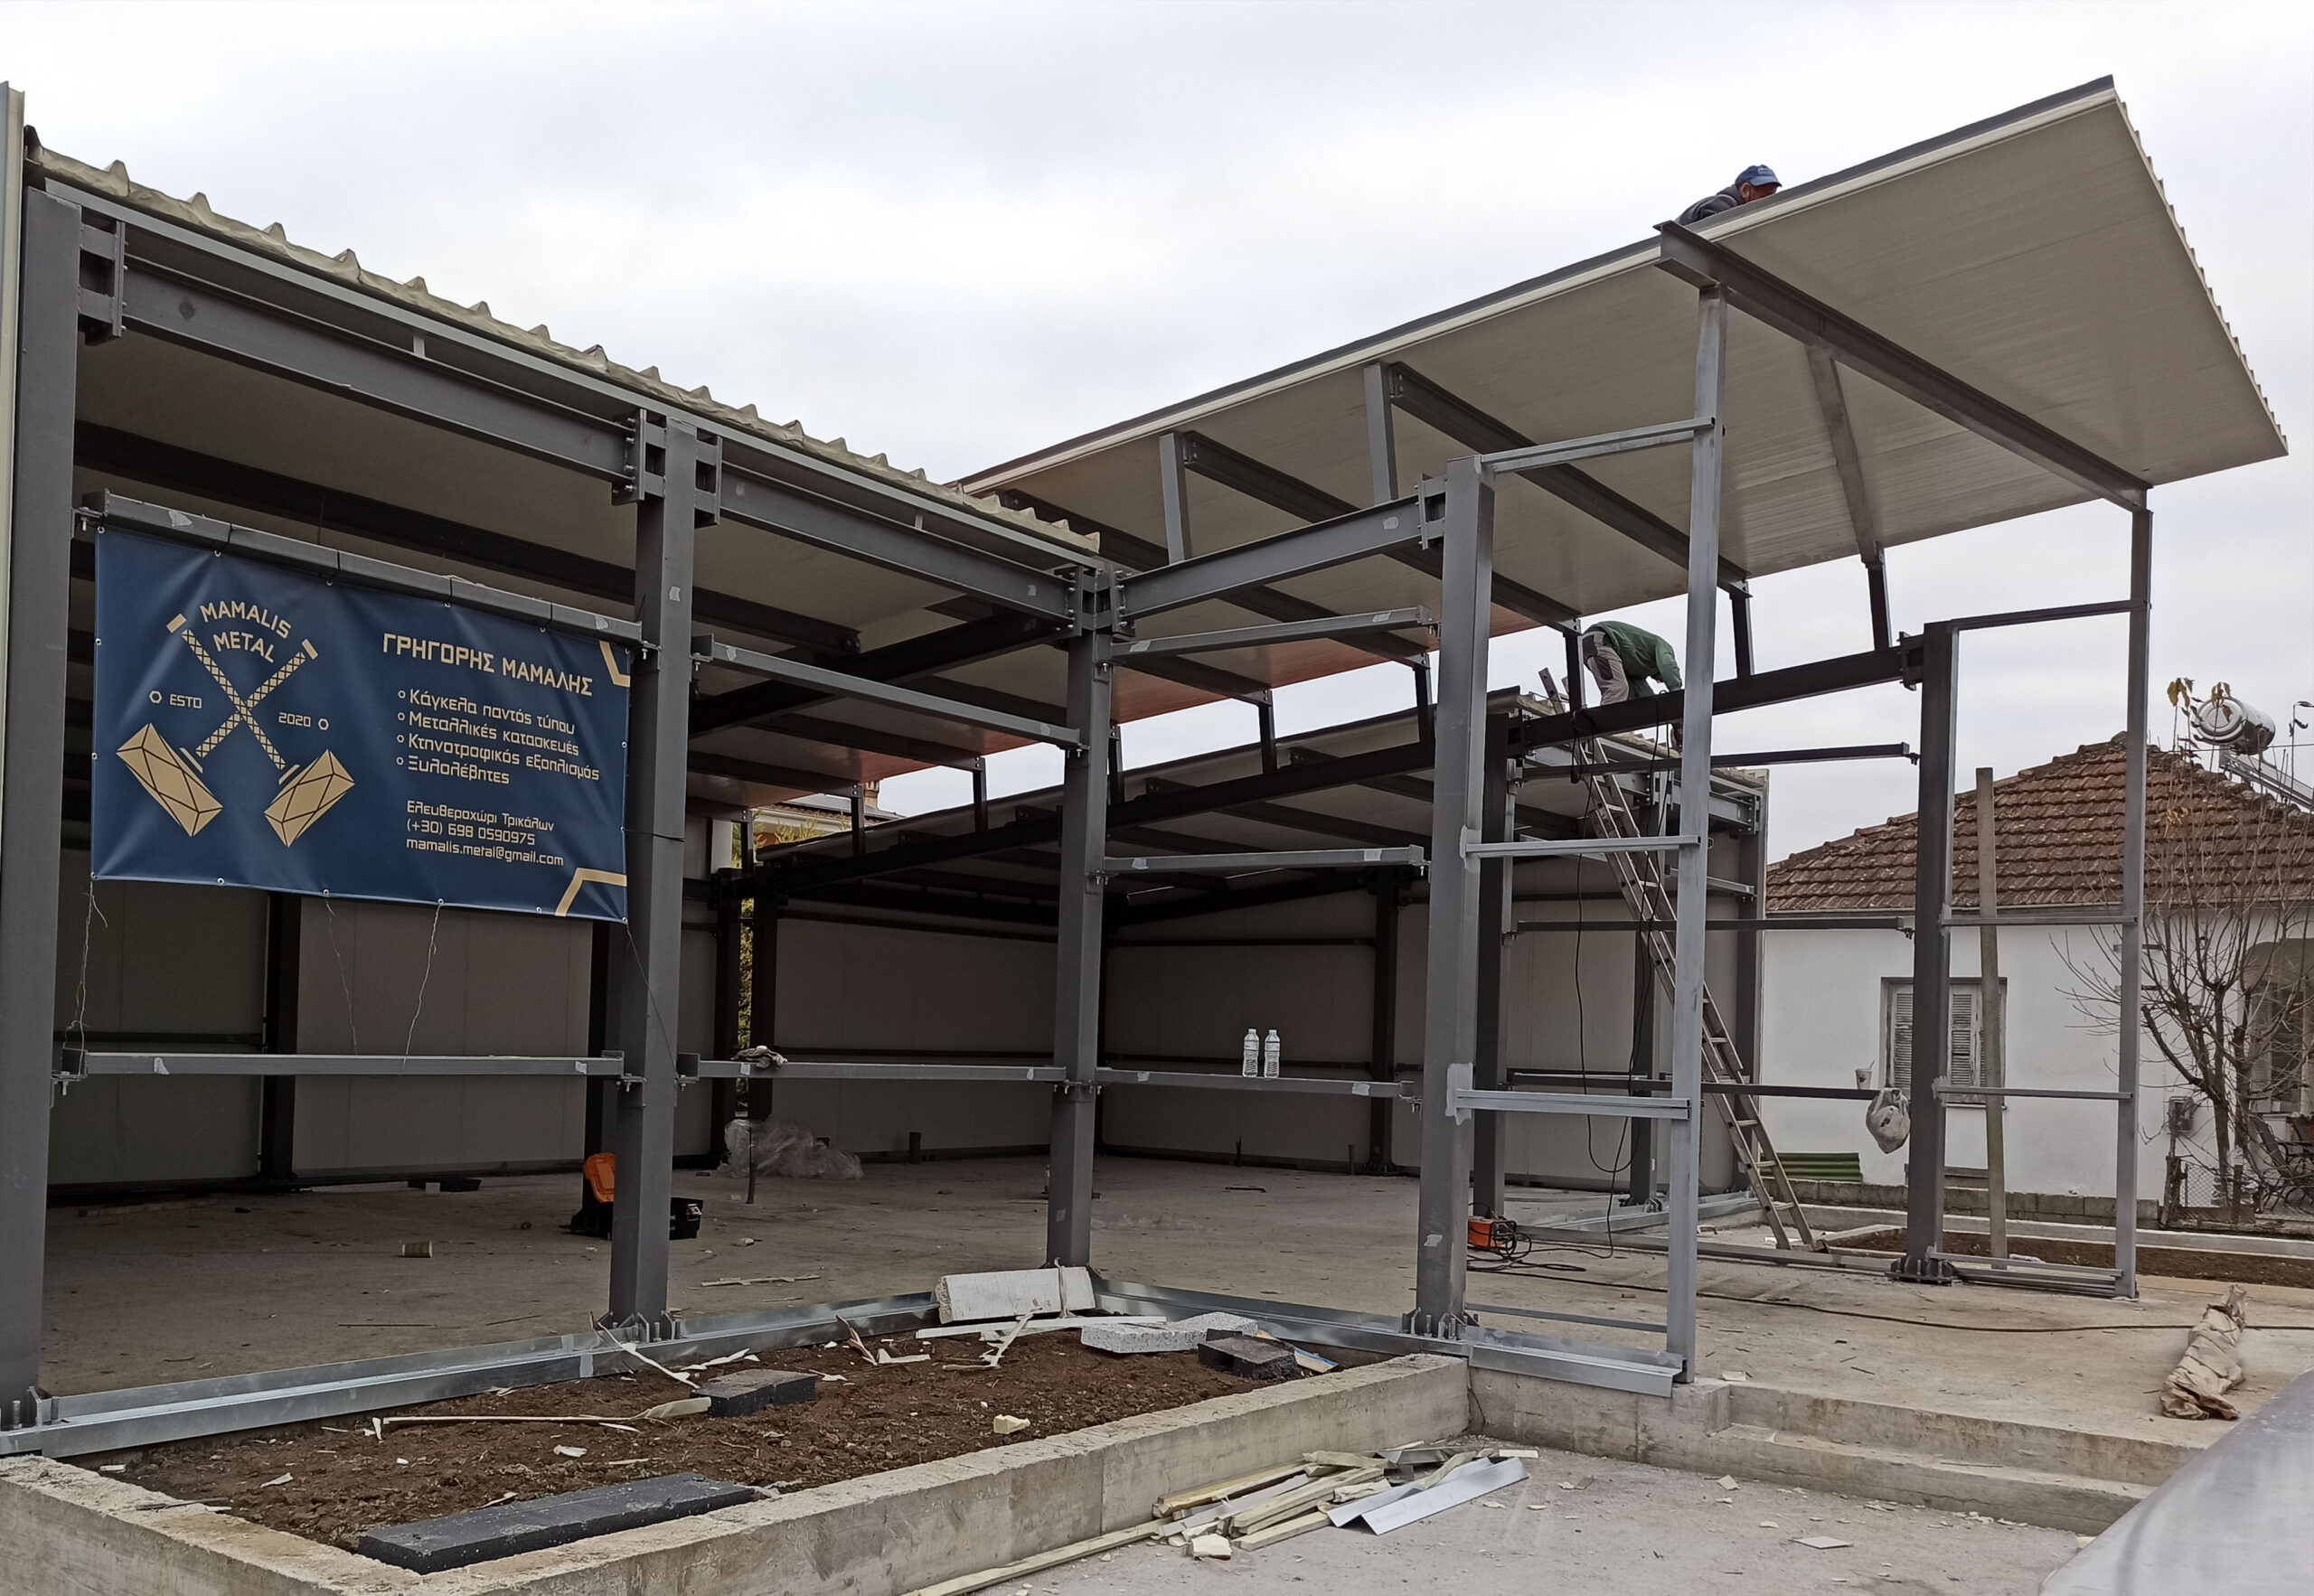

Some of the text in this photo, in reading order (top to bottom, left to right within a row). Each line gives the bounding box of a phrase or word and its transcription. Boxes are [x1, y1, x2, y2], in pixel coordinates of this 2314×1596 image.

[200, 600, 292, 639] MAMALIS
[213, 631, 275, 663] METAL
[382, 633, 593, 697] ΓΡΗΓΟΡΗΣ ΜΑΜΑΛΗΣ
[409, 689, 477, 715] Κάγκελα
[278, 711, 312, 728] 2020
[407, 818, 535, 845] (+30) 698 0590975
[407, 838, 564, 866] mamalis.metal@gmail.com
